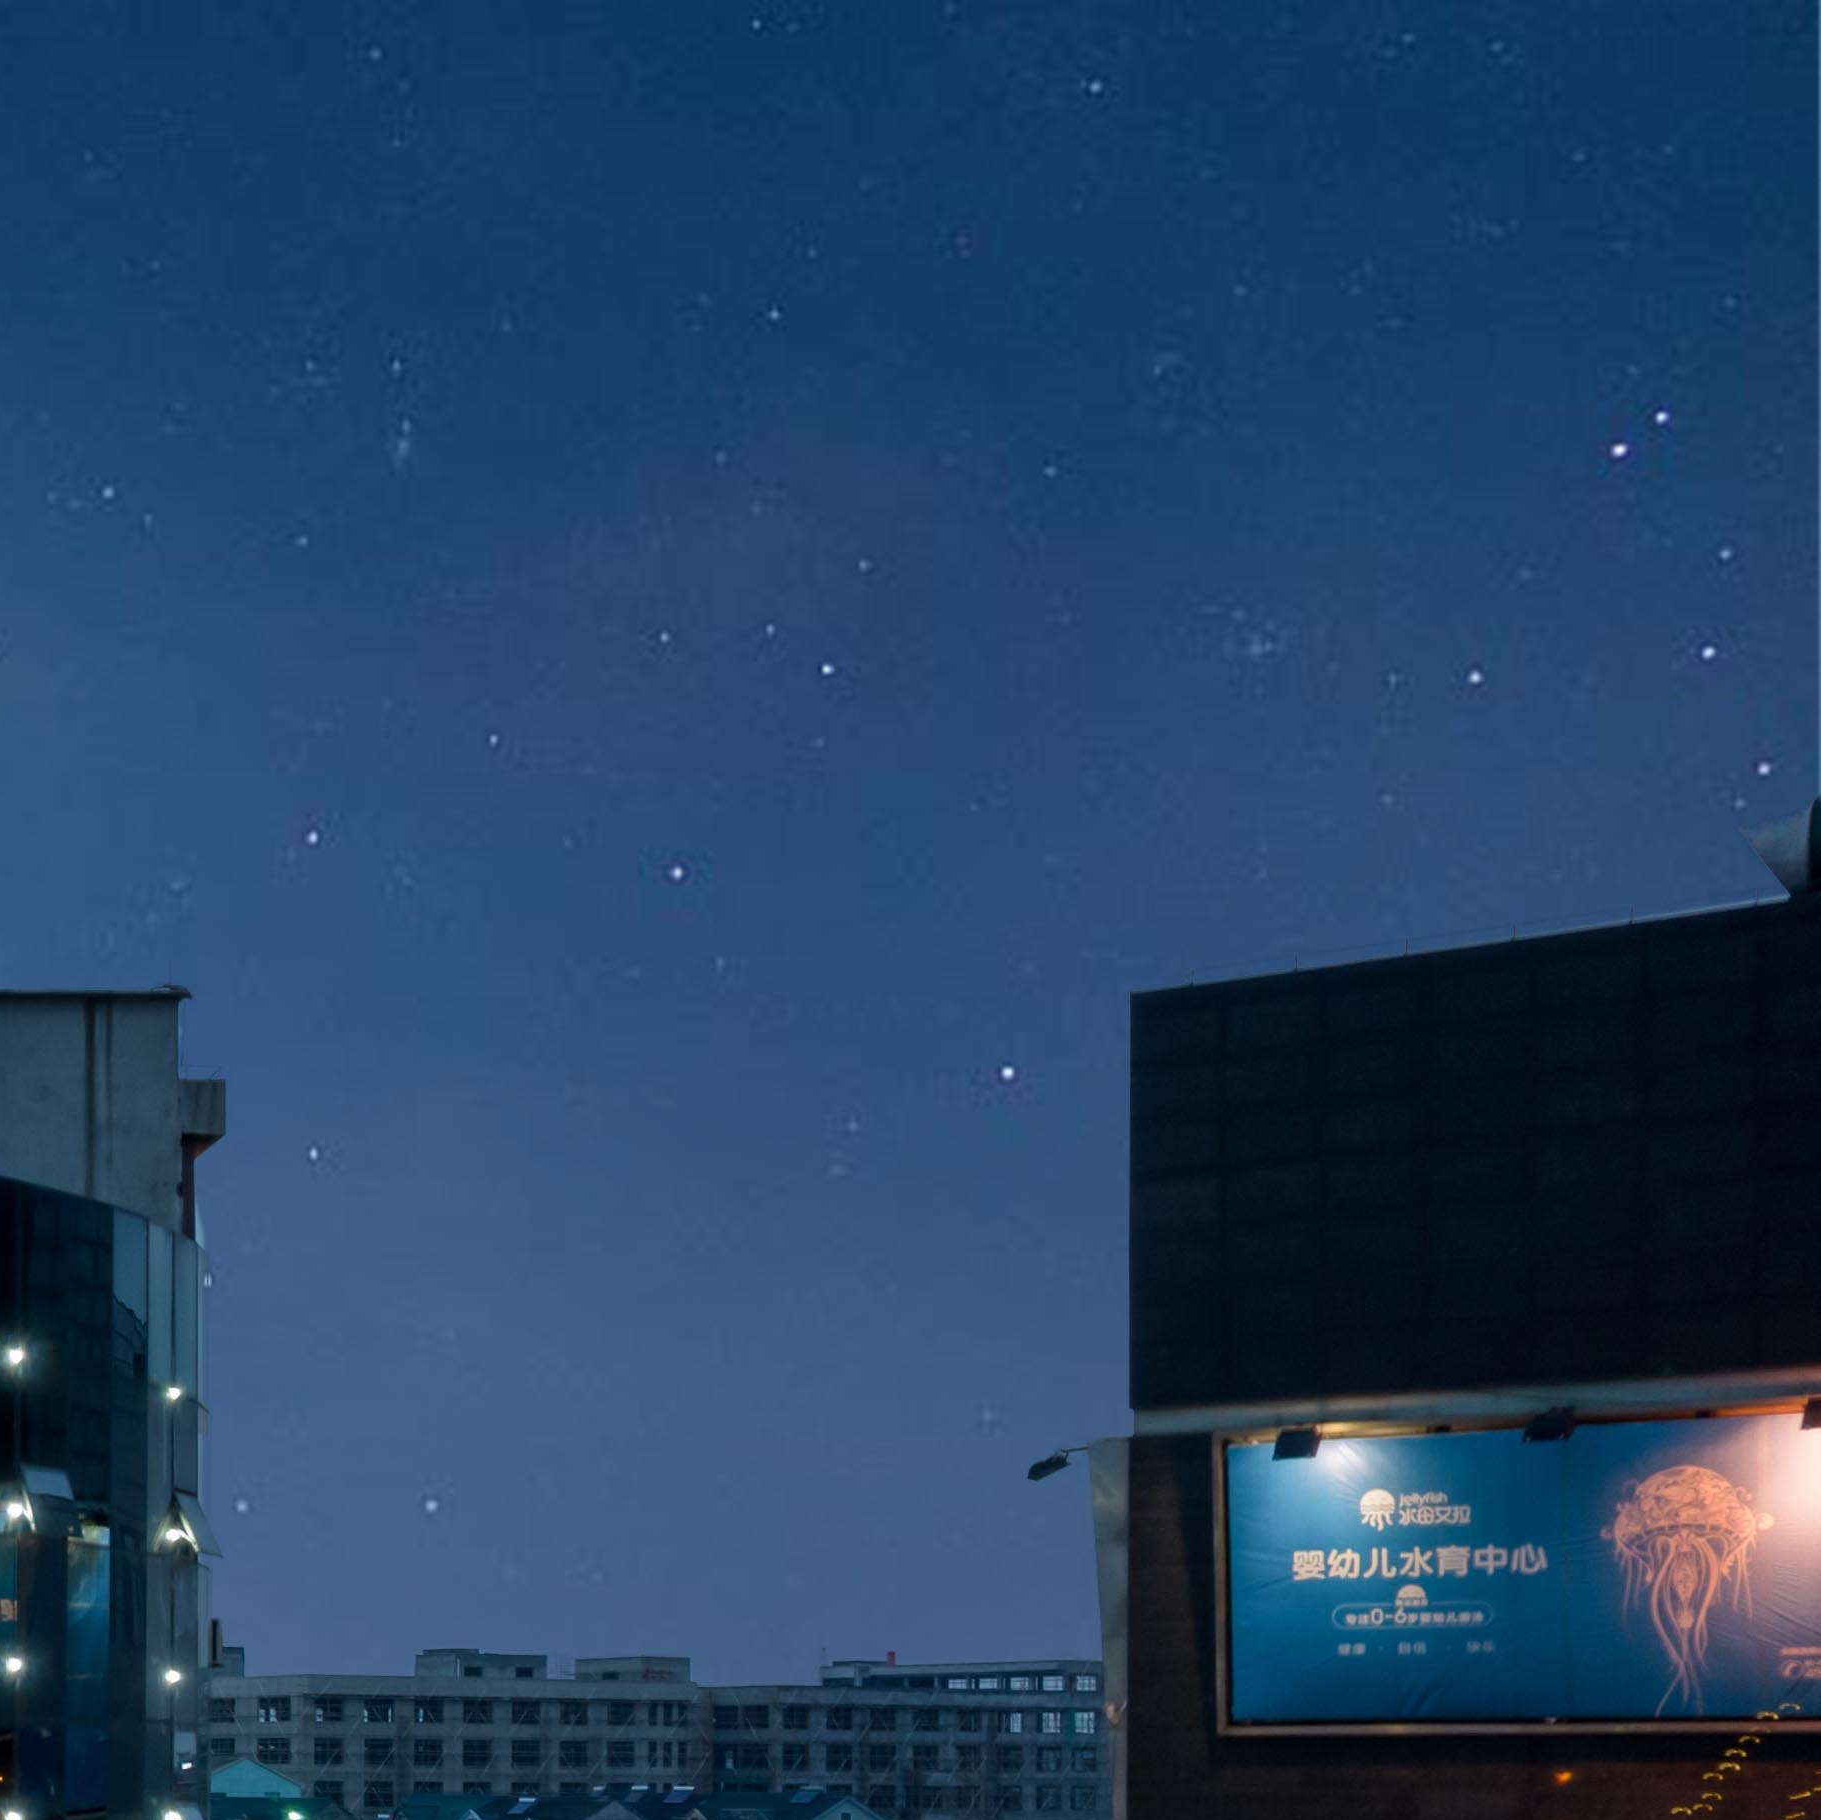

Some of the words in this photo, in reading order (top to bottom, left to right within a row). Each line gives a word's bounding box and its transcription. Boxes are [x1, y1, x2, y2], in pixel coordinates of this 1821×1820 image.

[1292, 1544, 1549, 1580] 婴幼儿水育中心
